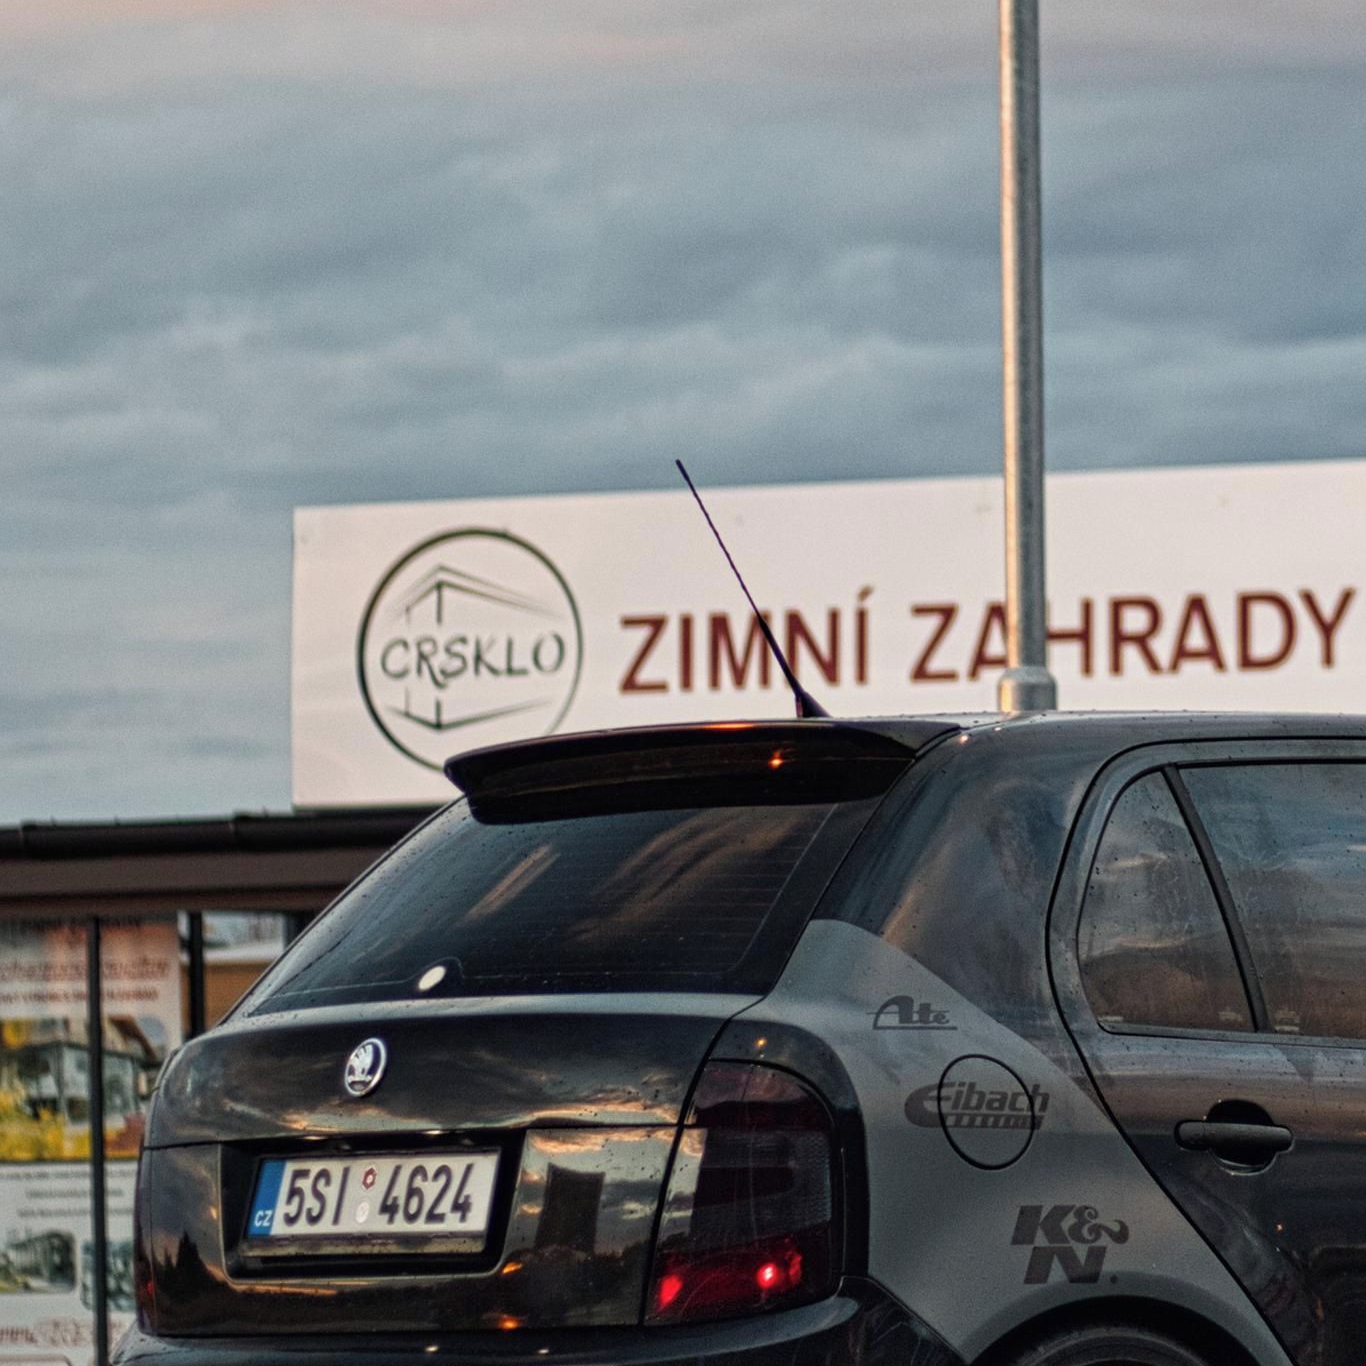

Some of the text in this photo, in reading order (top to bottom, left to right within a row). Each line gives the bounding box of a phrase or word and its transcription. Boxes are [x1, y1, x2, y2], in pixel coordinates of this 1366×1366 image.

[380, 631, 566, 689] CRSKLO
[619, 585, 1357, 694] ZIMNÍ ZAHRADY
[904, 1081, 1050, 1130] Eibach
[254, 1210, 273, 1227] CZ
[379, 1163, 475, 1225] 4624
